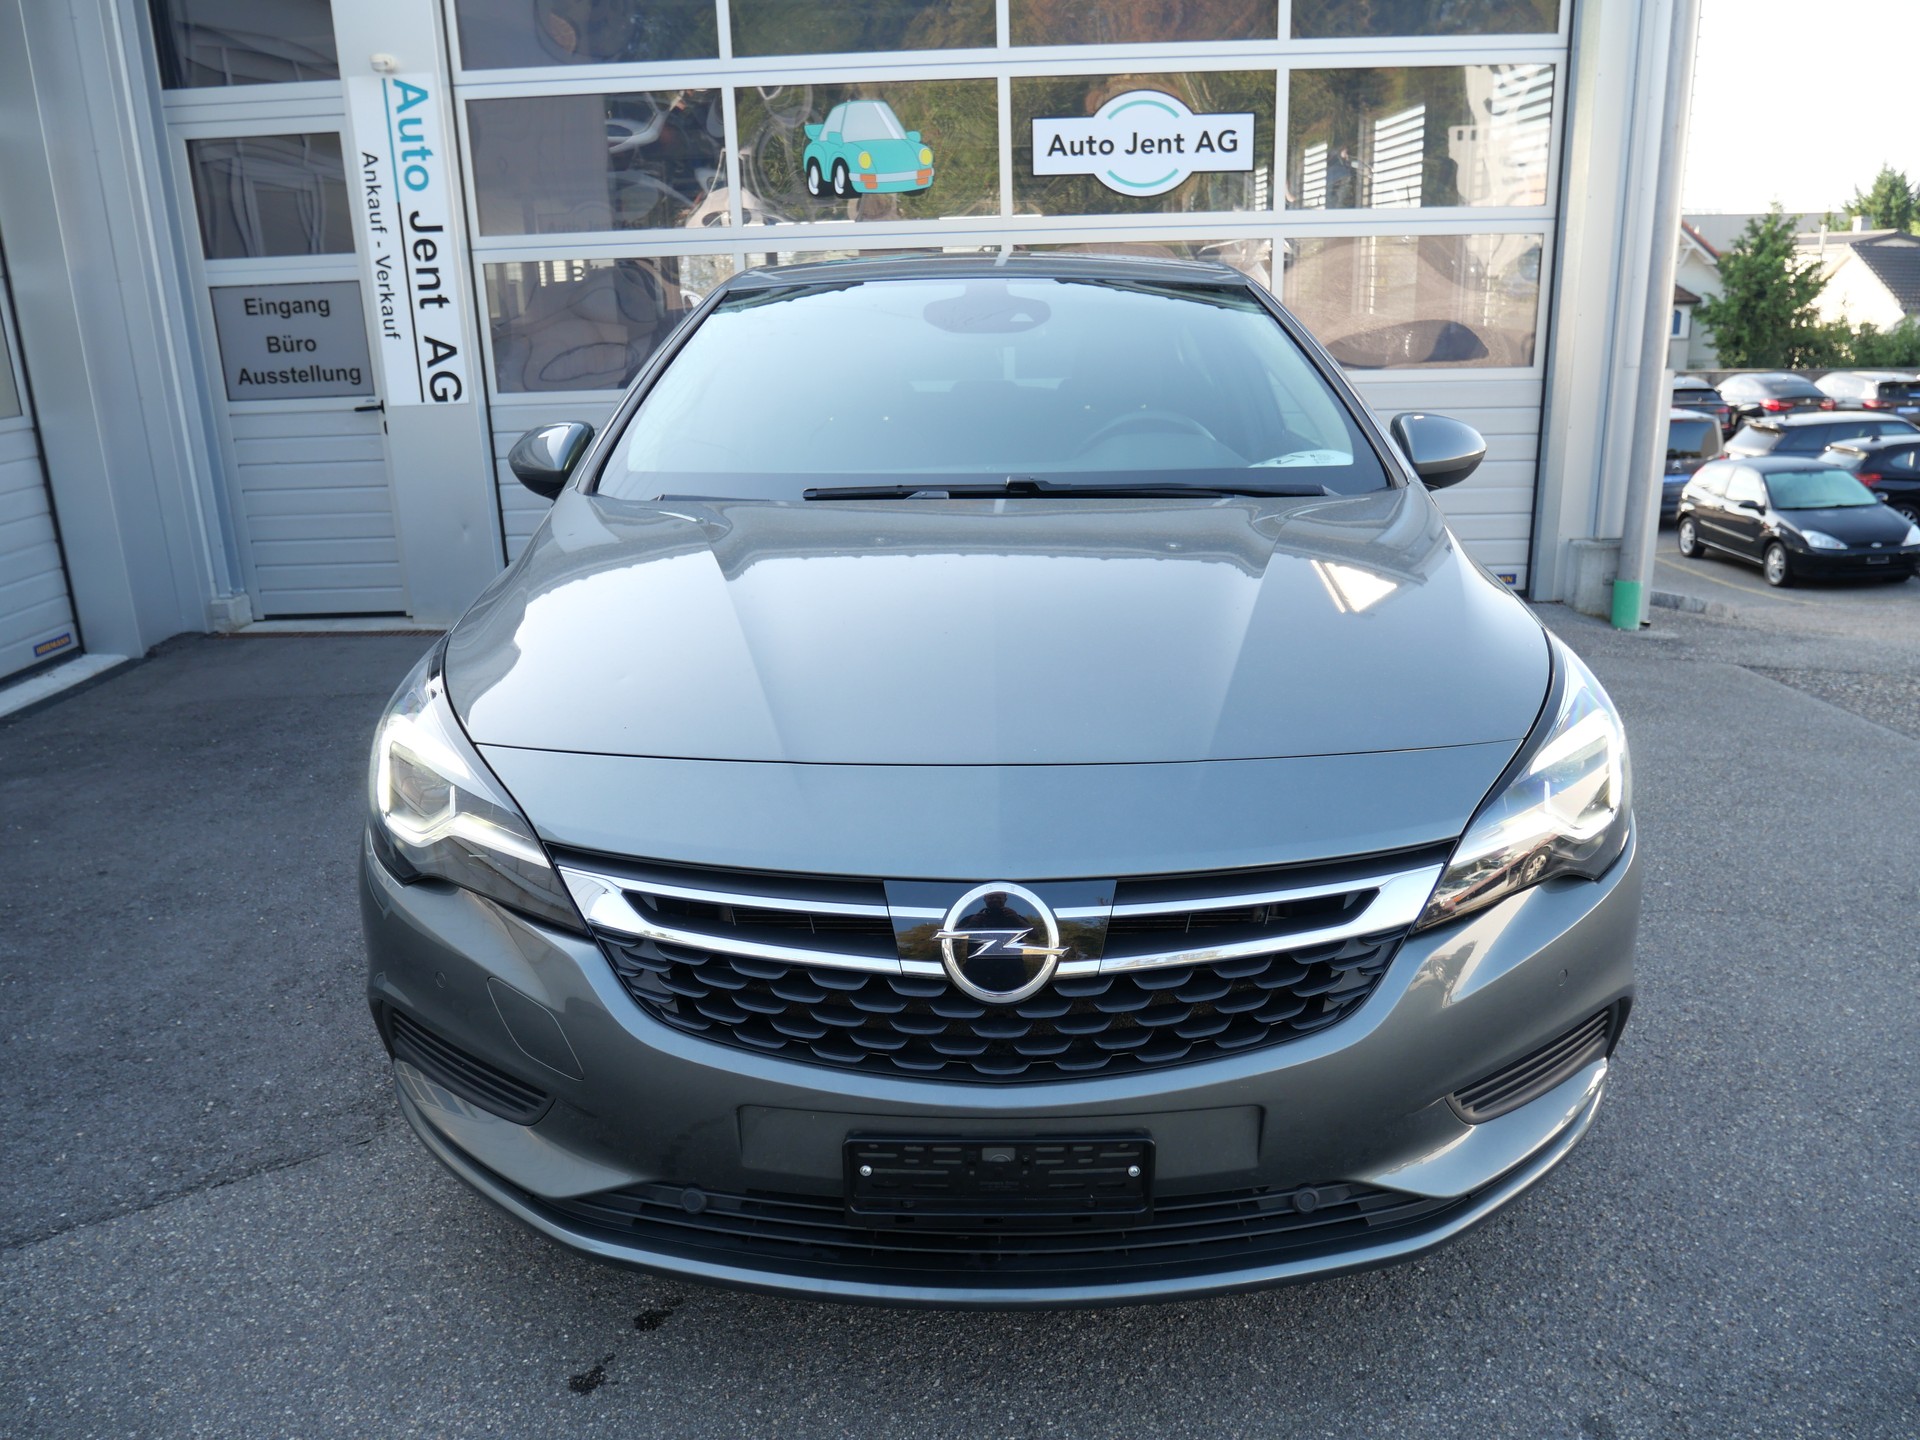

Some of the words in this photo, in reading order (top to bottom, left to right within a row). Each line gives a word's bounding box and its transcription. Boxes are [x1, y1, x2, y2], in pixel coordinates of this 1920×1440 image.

[393, 78, 434, 192] Auto
[1047, 134, 1115, 157] Auto
[1124, 132, 1185, 155] Jent
[1194, 129, 1239, 154] AG
[361, 151, 388, 234] Ankauf
[375, 255, 402, 340] Verkauf
[409, 210, 451, 309] Jent
[243, 297, 331, 319] Eingang
[266, 335, 317, 353] Büro
[238, 364, 362, 386] Ausstellung
[423, 335, 462, 403] AG
